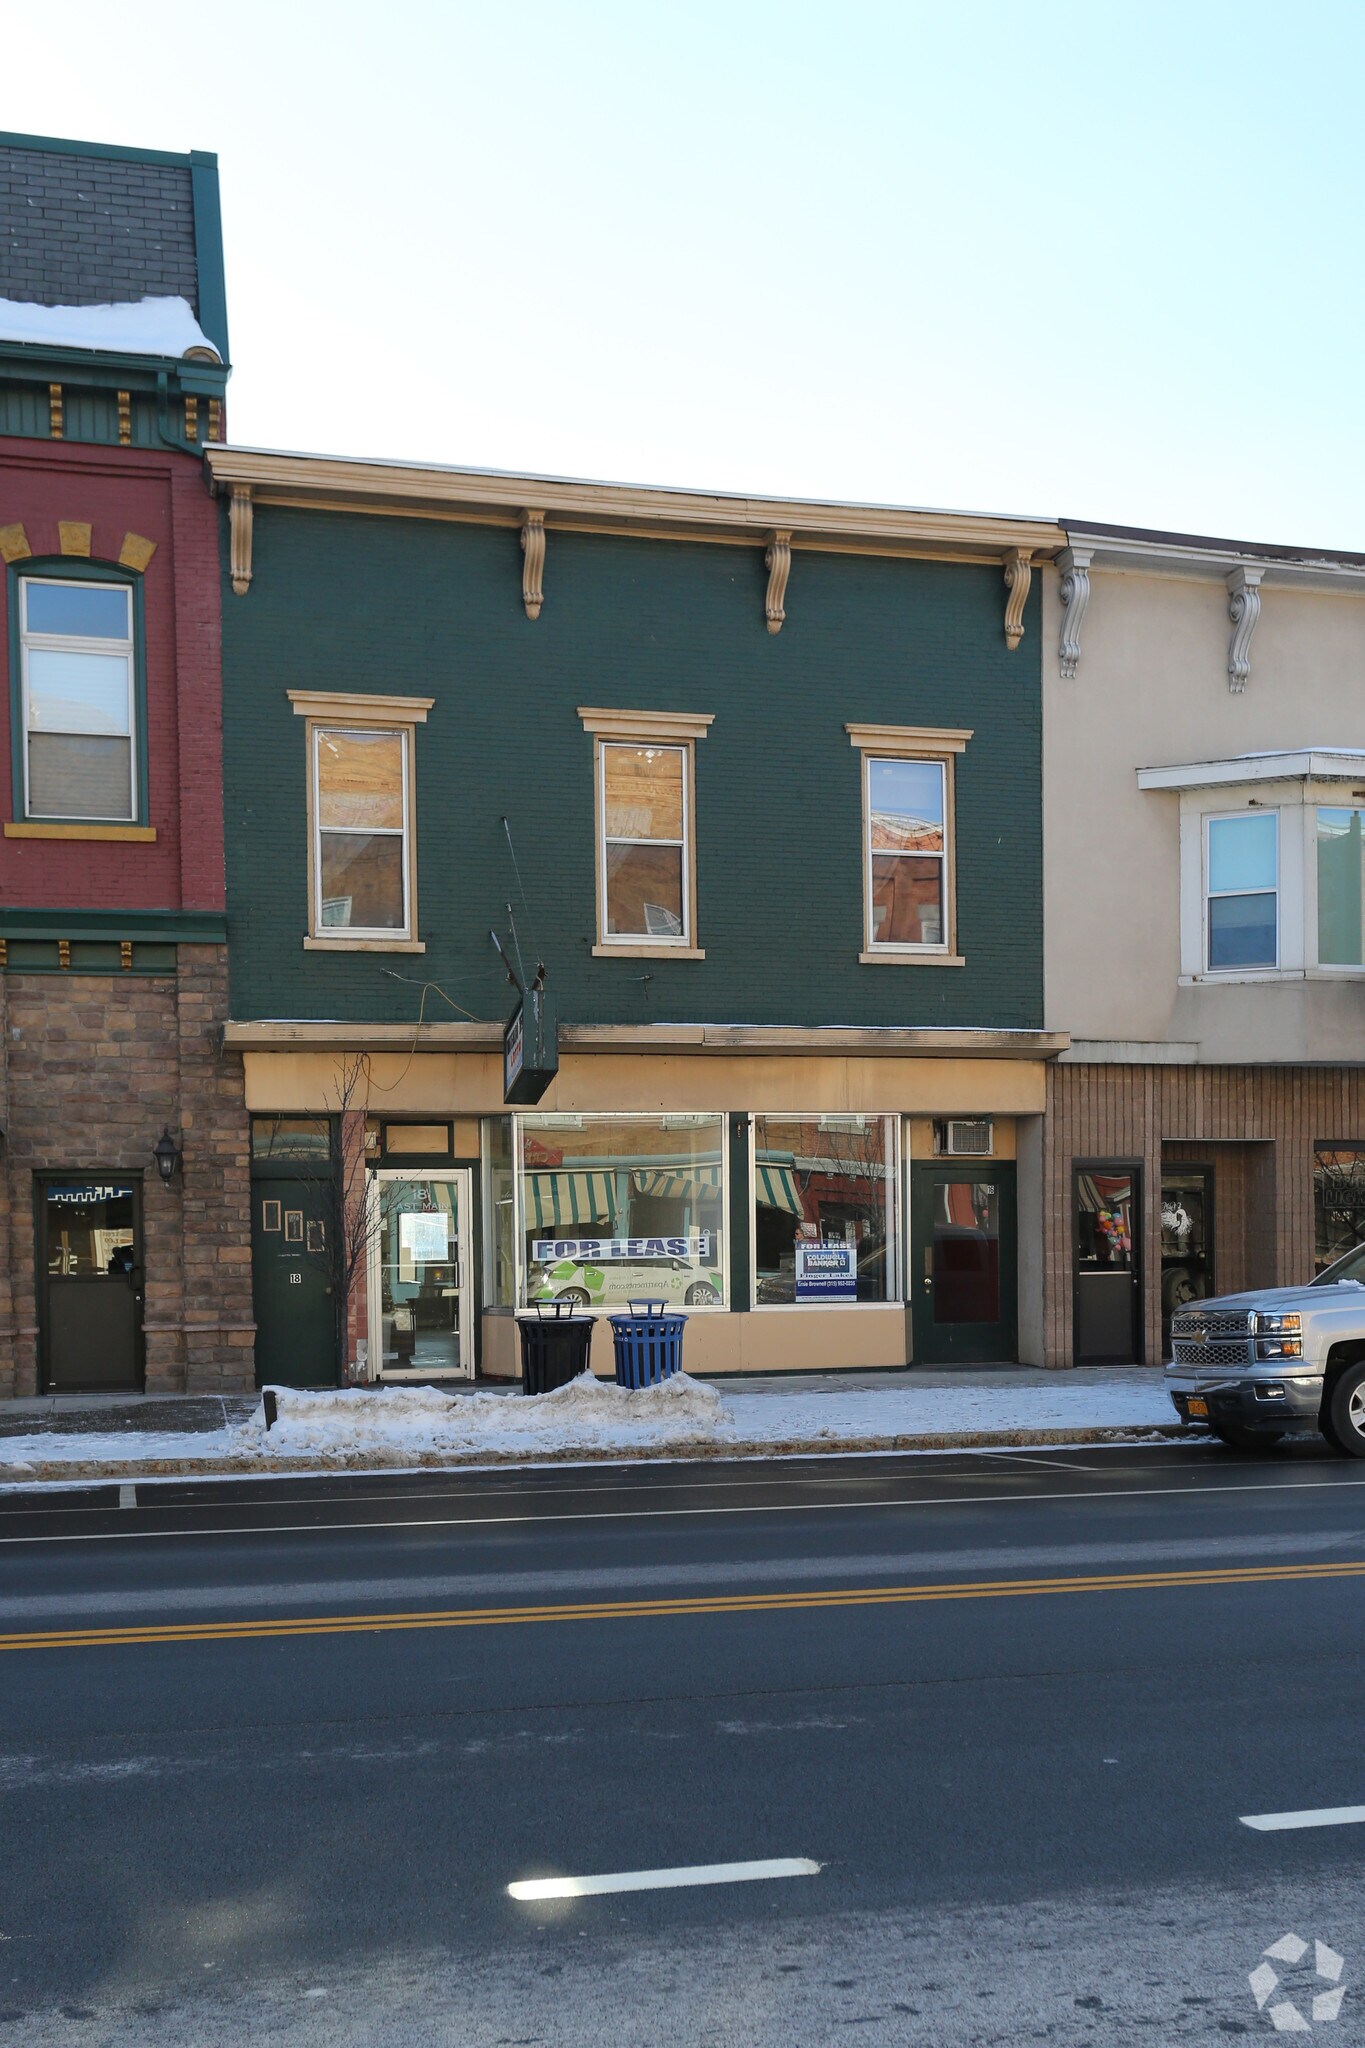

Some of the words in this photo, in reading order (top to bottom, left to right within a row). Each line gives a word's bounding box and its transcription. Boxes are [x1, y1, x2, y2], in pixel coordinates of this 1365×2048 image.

[412, 1189, 428, 1200] 18
[422, 1202, 450, 1211] MAIN
[537, 1240, 601, 1259] FOR
[610, 1238, 706, 1257] LEASE
[290, 1273, 301, 1284] 18
